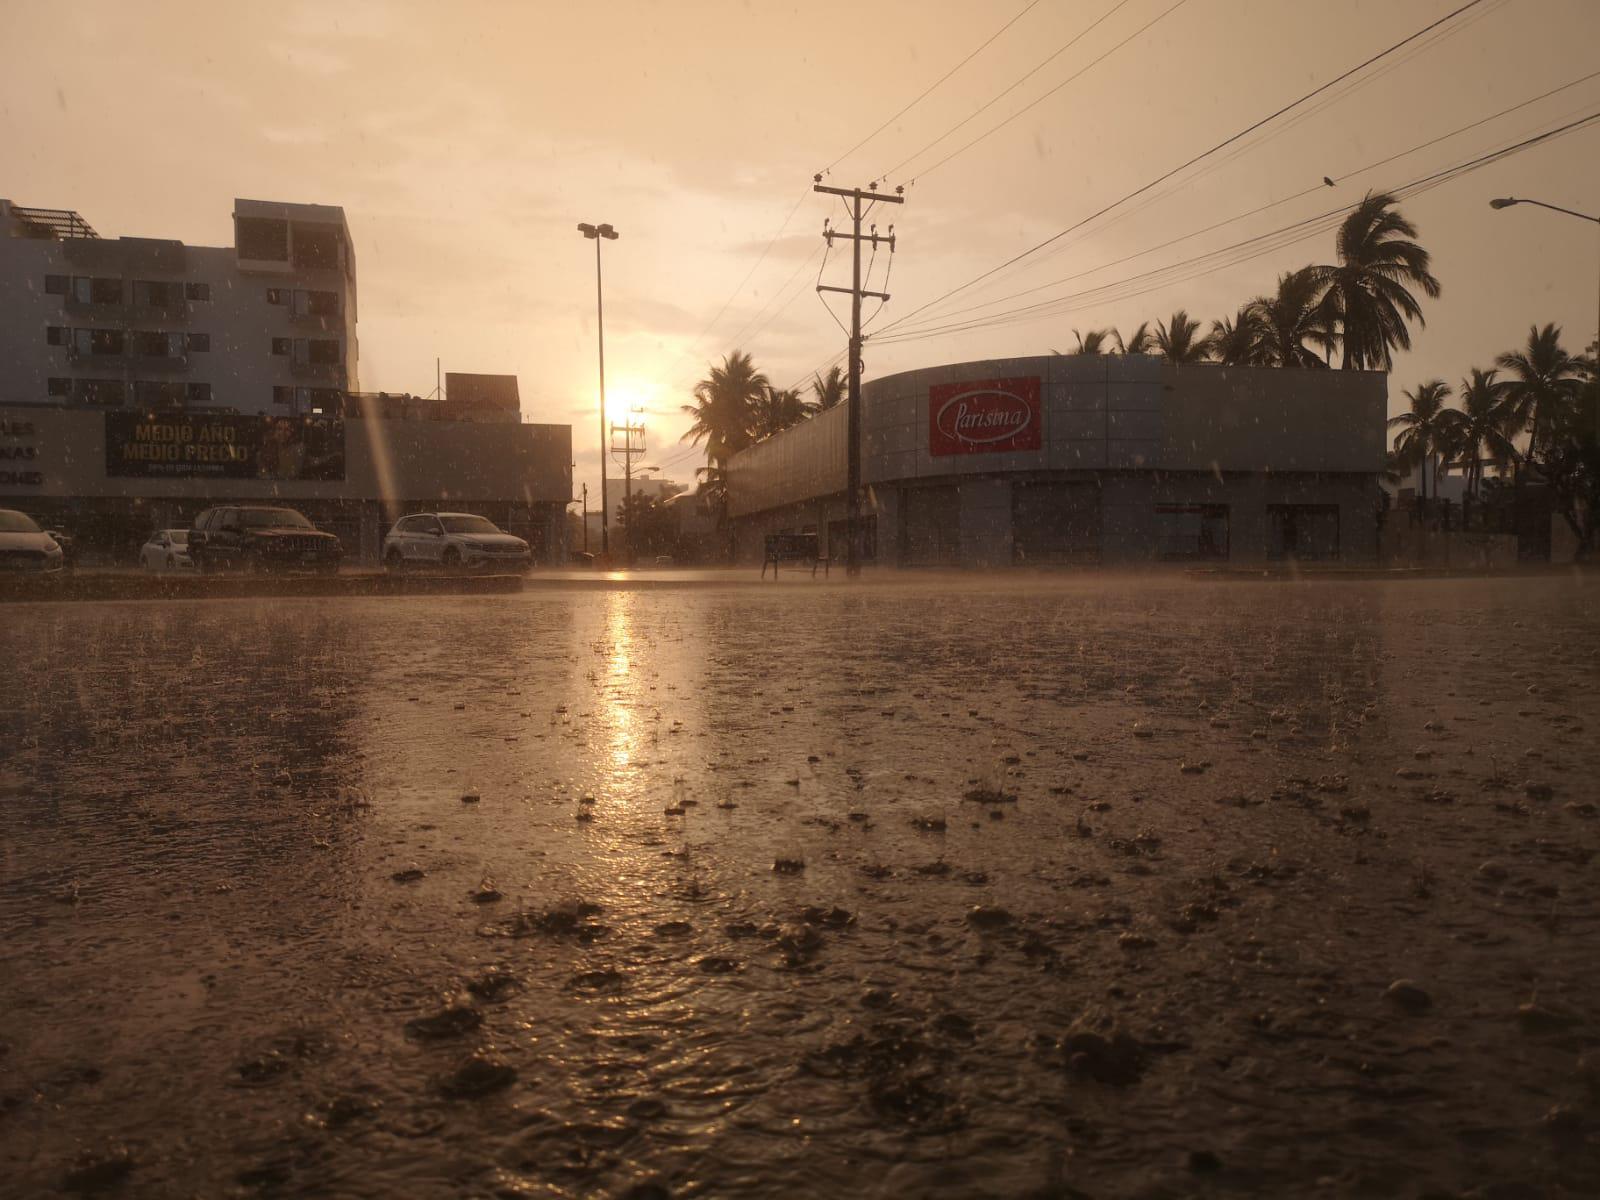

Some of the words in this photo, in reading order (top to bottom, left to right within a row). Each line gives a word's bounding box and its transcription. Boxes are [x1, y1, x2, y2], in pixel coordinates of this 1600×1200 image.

[955, 403, 1022, 432] Parisina
[135, 424, 193, 441] MEDIO
[123, 443, 180, 460] MEDIO
[185, 444, 249, 461] PRECIO
